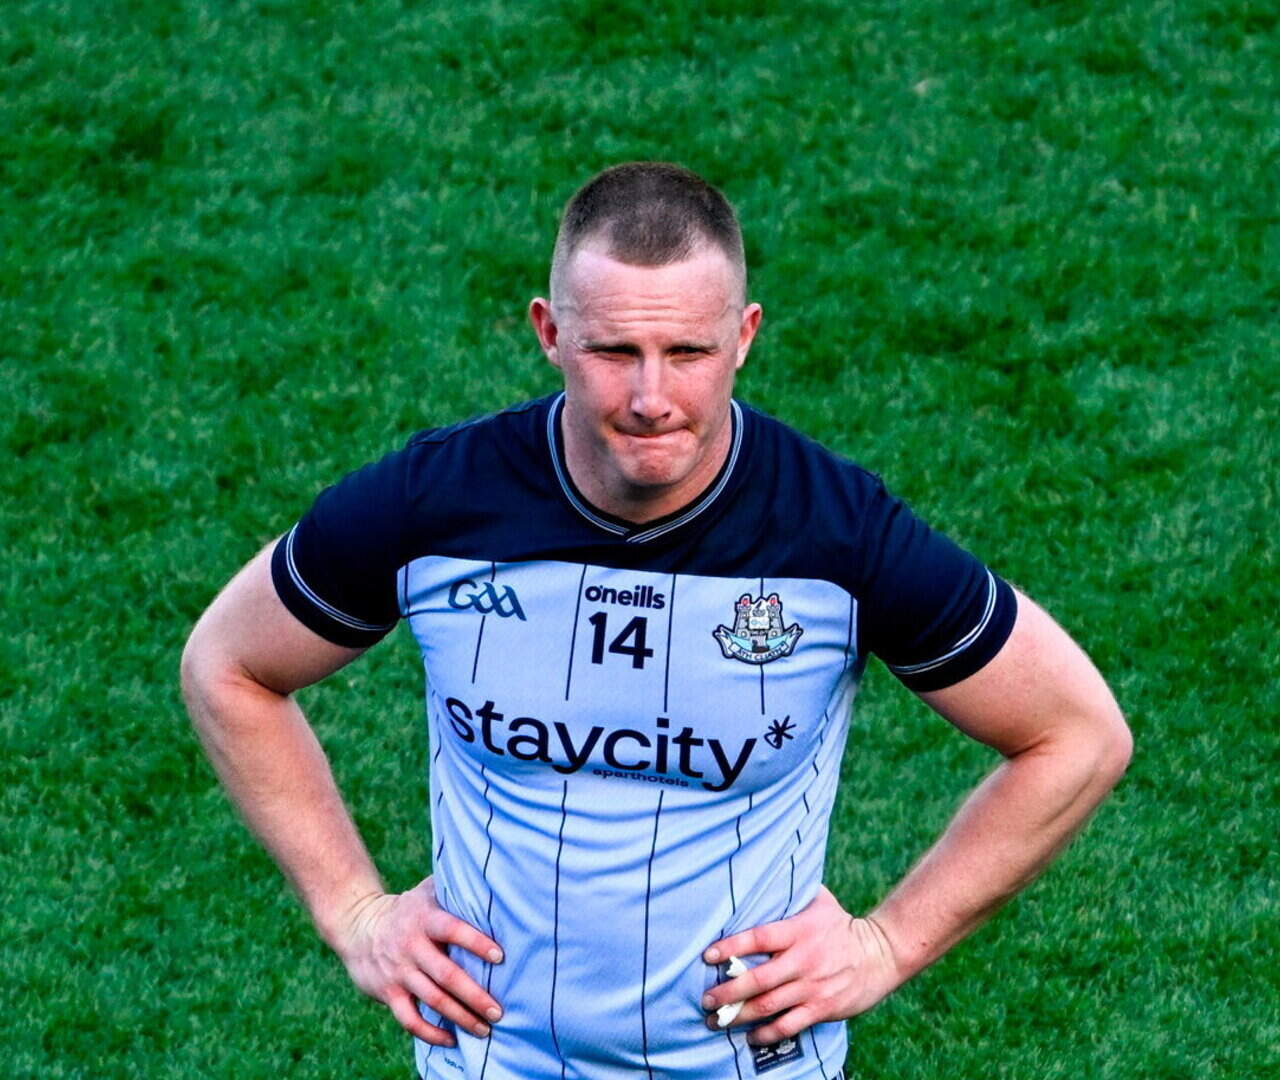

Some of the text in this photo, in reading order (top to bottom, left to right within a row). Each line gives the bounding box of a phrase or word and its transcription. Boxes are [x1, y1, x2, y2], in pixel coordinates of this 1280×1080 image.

[588, 611, 654, 669] 14
[445, 697, 758, 792] staycity
[592, 767, 689, 787] aparthotels
